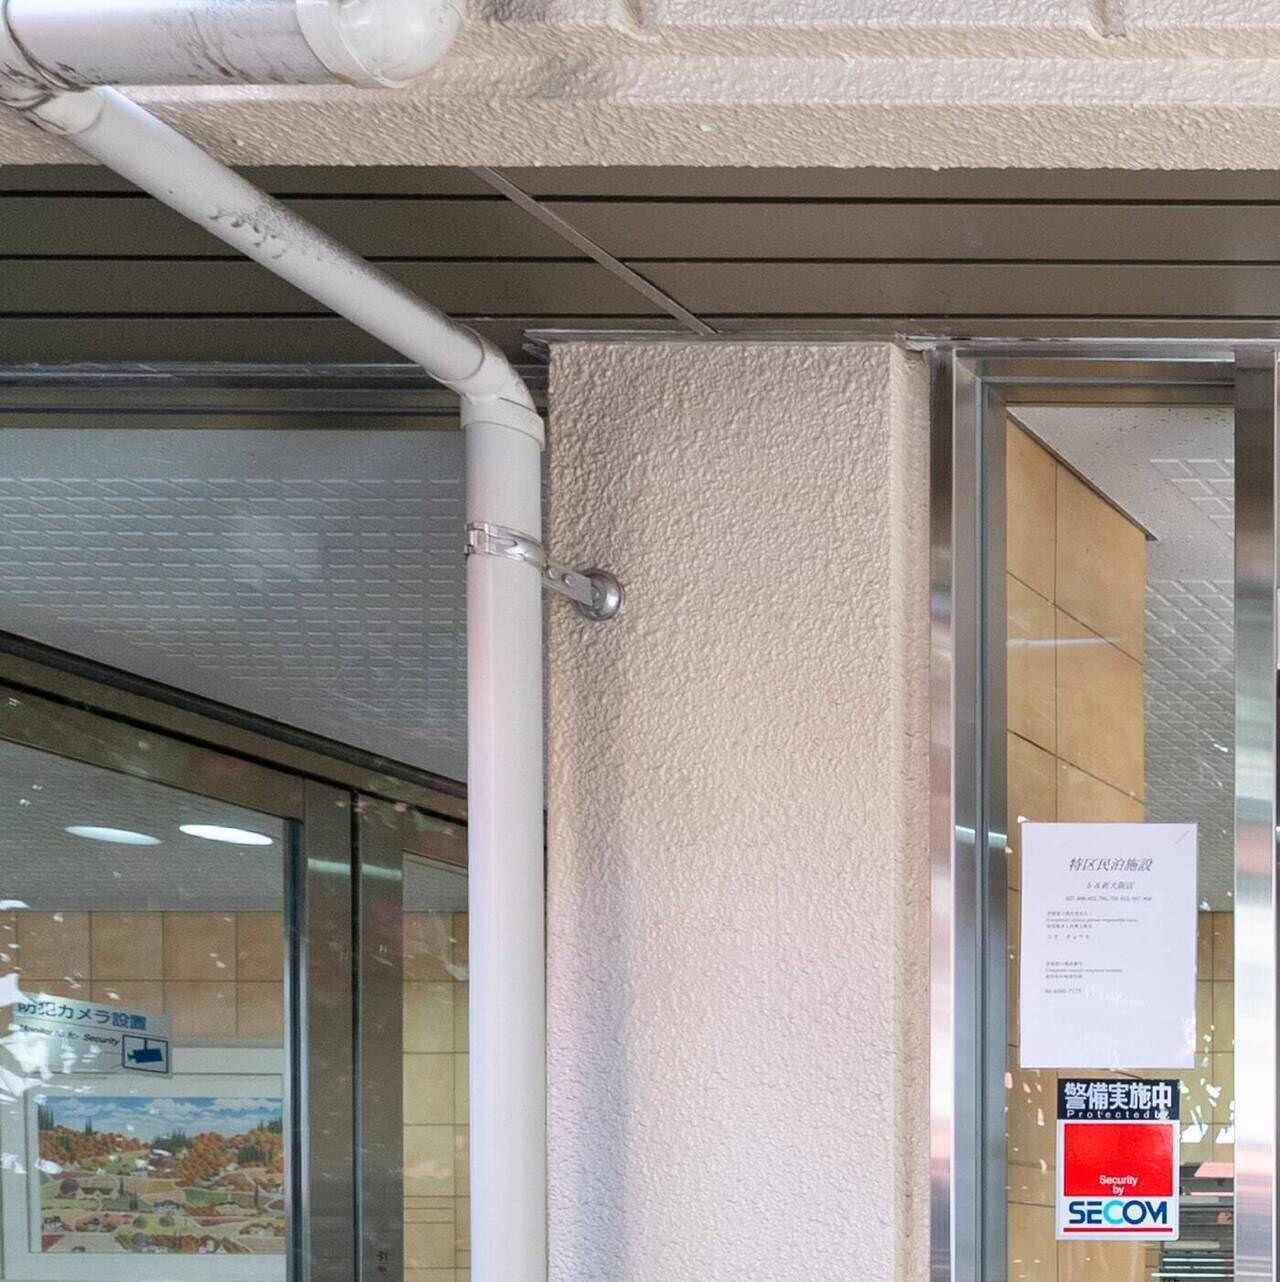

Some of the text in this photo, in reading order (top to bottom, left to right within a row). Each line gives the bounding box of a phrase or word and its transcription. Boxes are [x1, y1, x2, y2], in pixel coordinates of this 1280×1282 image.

[1068, 856, 1153, 872] 特区民泊施設
[82, 1033, 120, 1046] Security
[1064, 1081, 1172, 1110] 警備実施中
[1066, 1110, 1150, 1119] Protected
[1099, 1175, 1138, 1187] Security
[1112, 1185, 1124, 1196] by
[1068, 1199, 1168, 1225] SECOM
